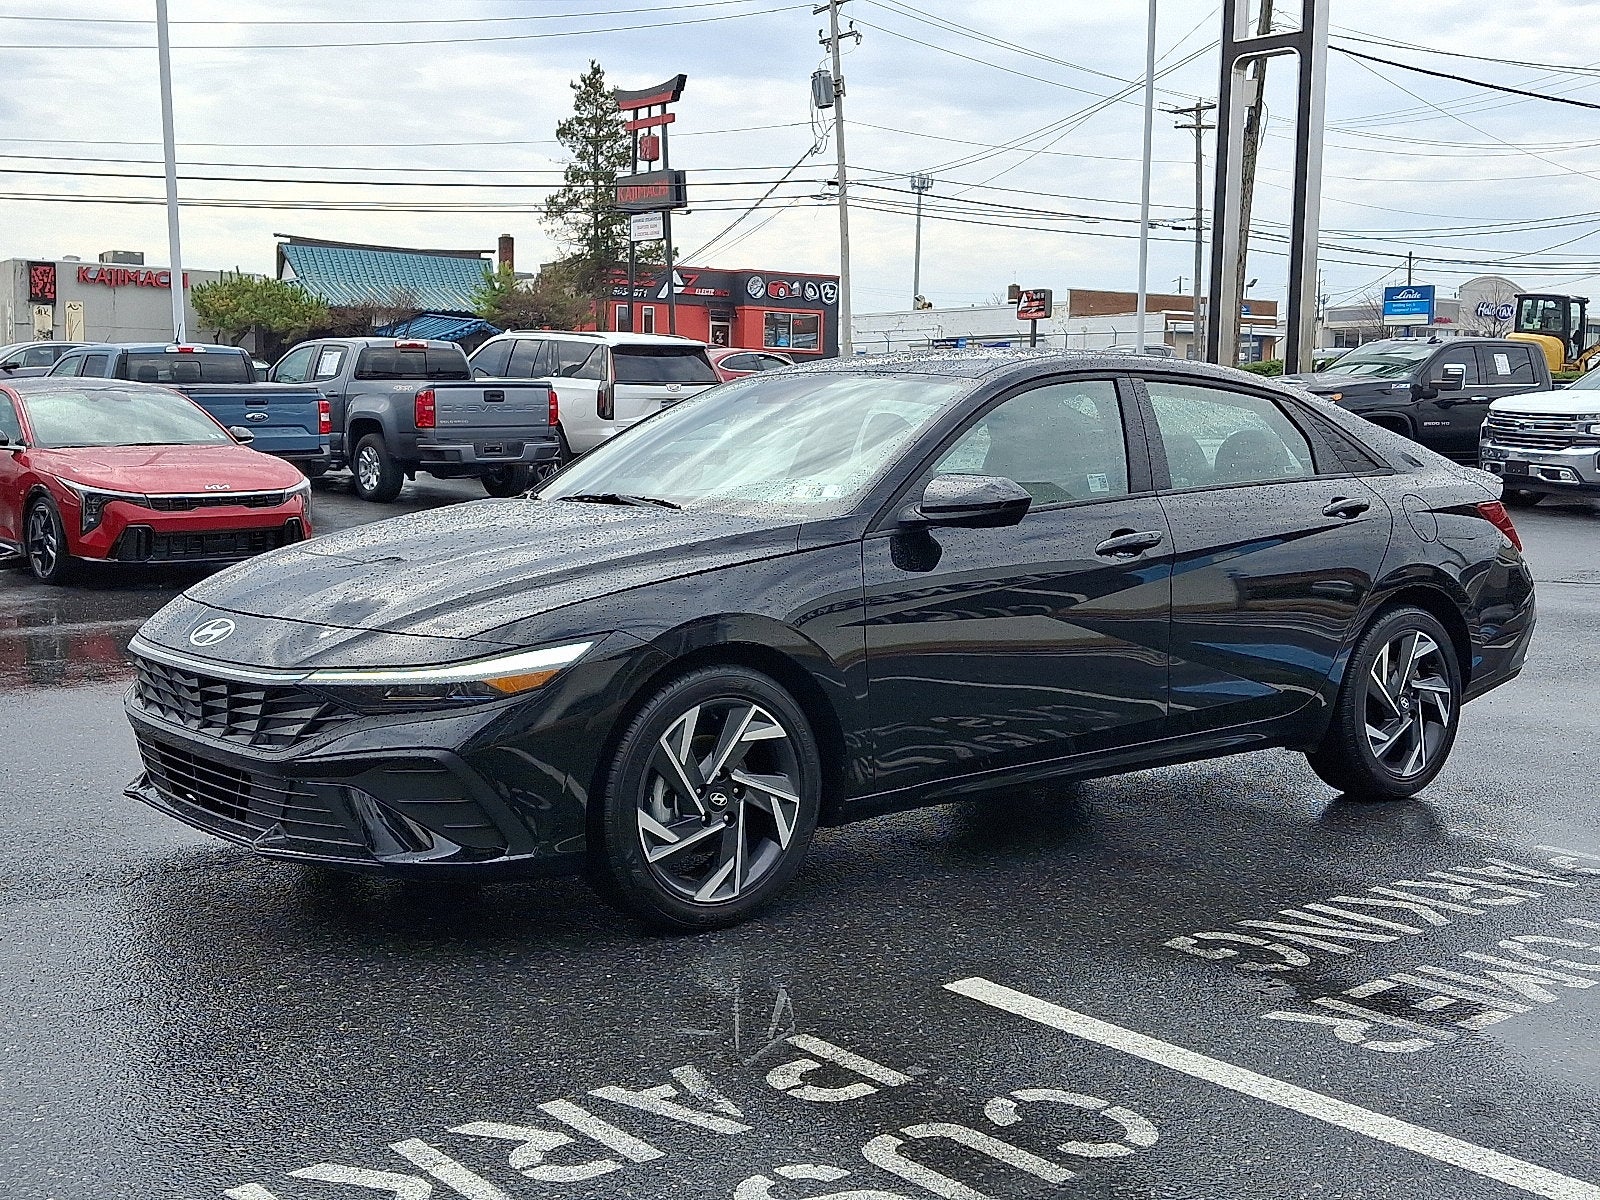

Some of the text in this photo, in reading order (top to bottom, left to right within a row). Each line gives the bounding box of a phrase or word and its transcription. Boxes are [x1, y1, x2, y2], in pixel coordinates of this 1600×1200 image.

[77, 266, 189, 289] KAJIMACI
[1392, 288, 1421, 299] Linde
[440, 404, 546, 413] CHEVROLET
